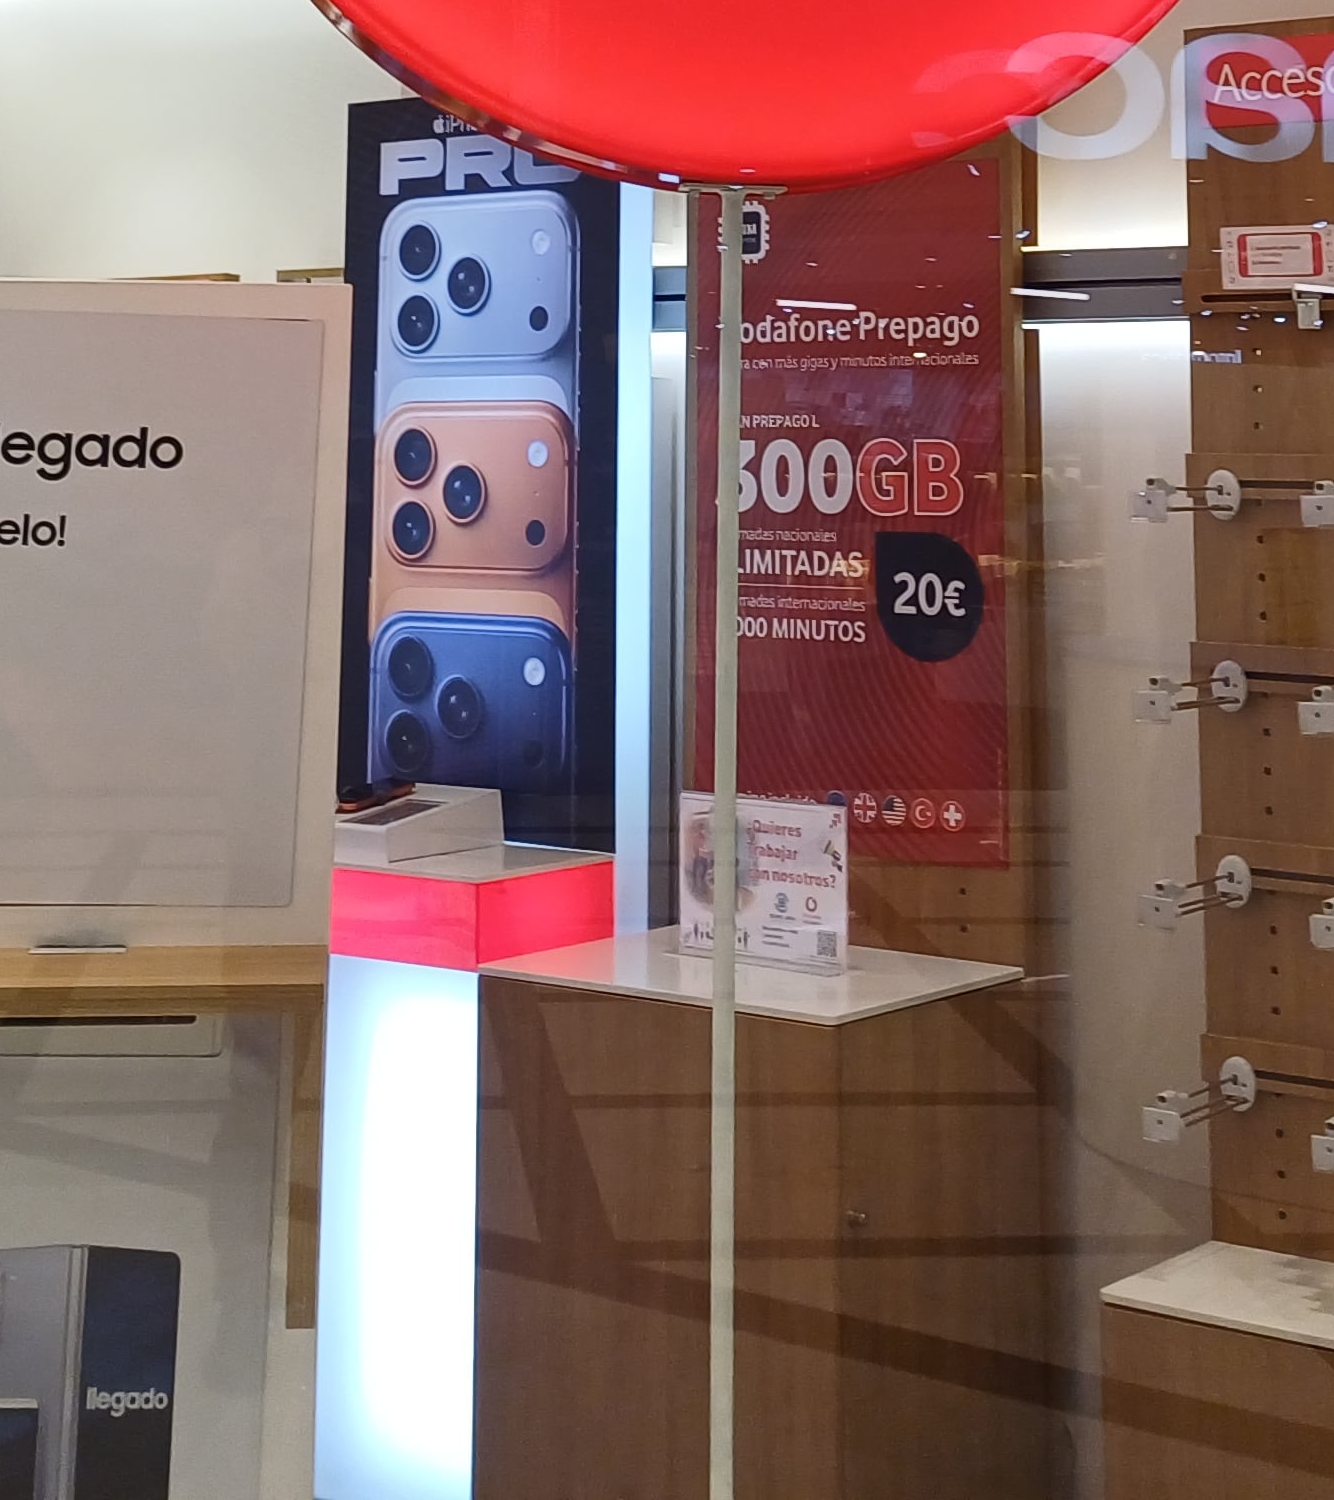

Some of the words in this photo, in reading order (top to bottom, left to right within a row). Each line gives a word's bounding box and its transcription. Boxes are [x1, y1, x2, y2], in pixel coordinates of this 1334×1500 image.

[740, 313, 851, 344] odafone
[858, 311, 980, 347] Prepago
[752, 414, 810, 429] PREPAGO
[738, 549, 864, 578] IMITADAS
[893, 572, 966, 617] 20€
[772, 618, 866, 643] MINUTOS
[85, 1386, 169, 1418] llegado
